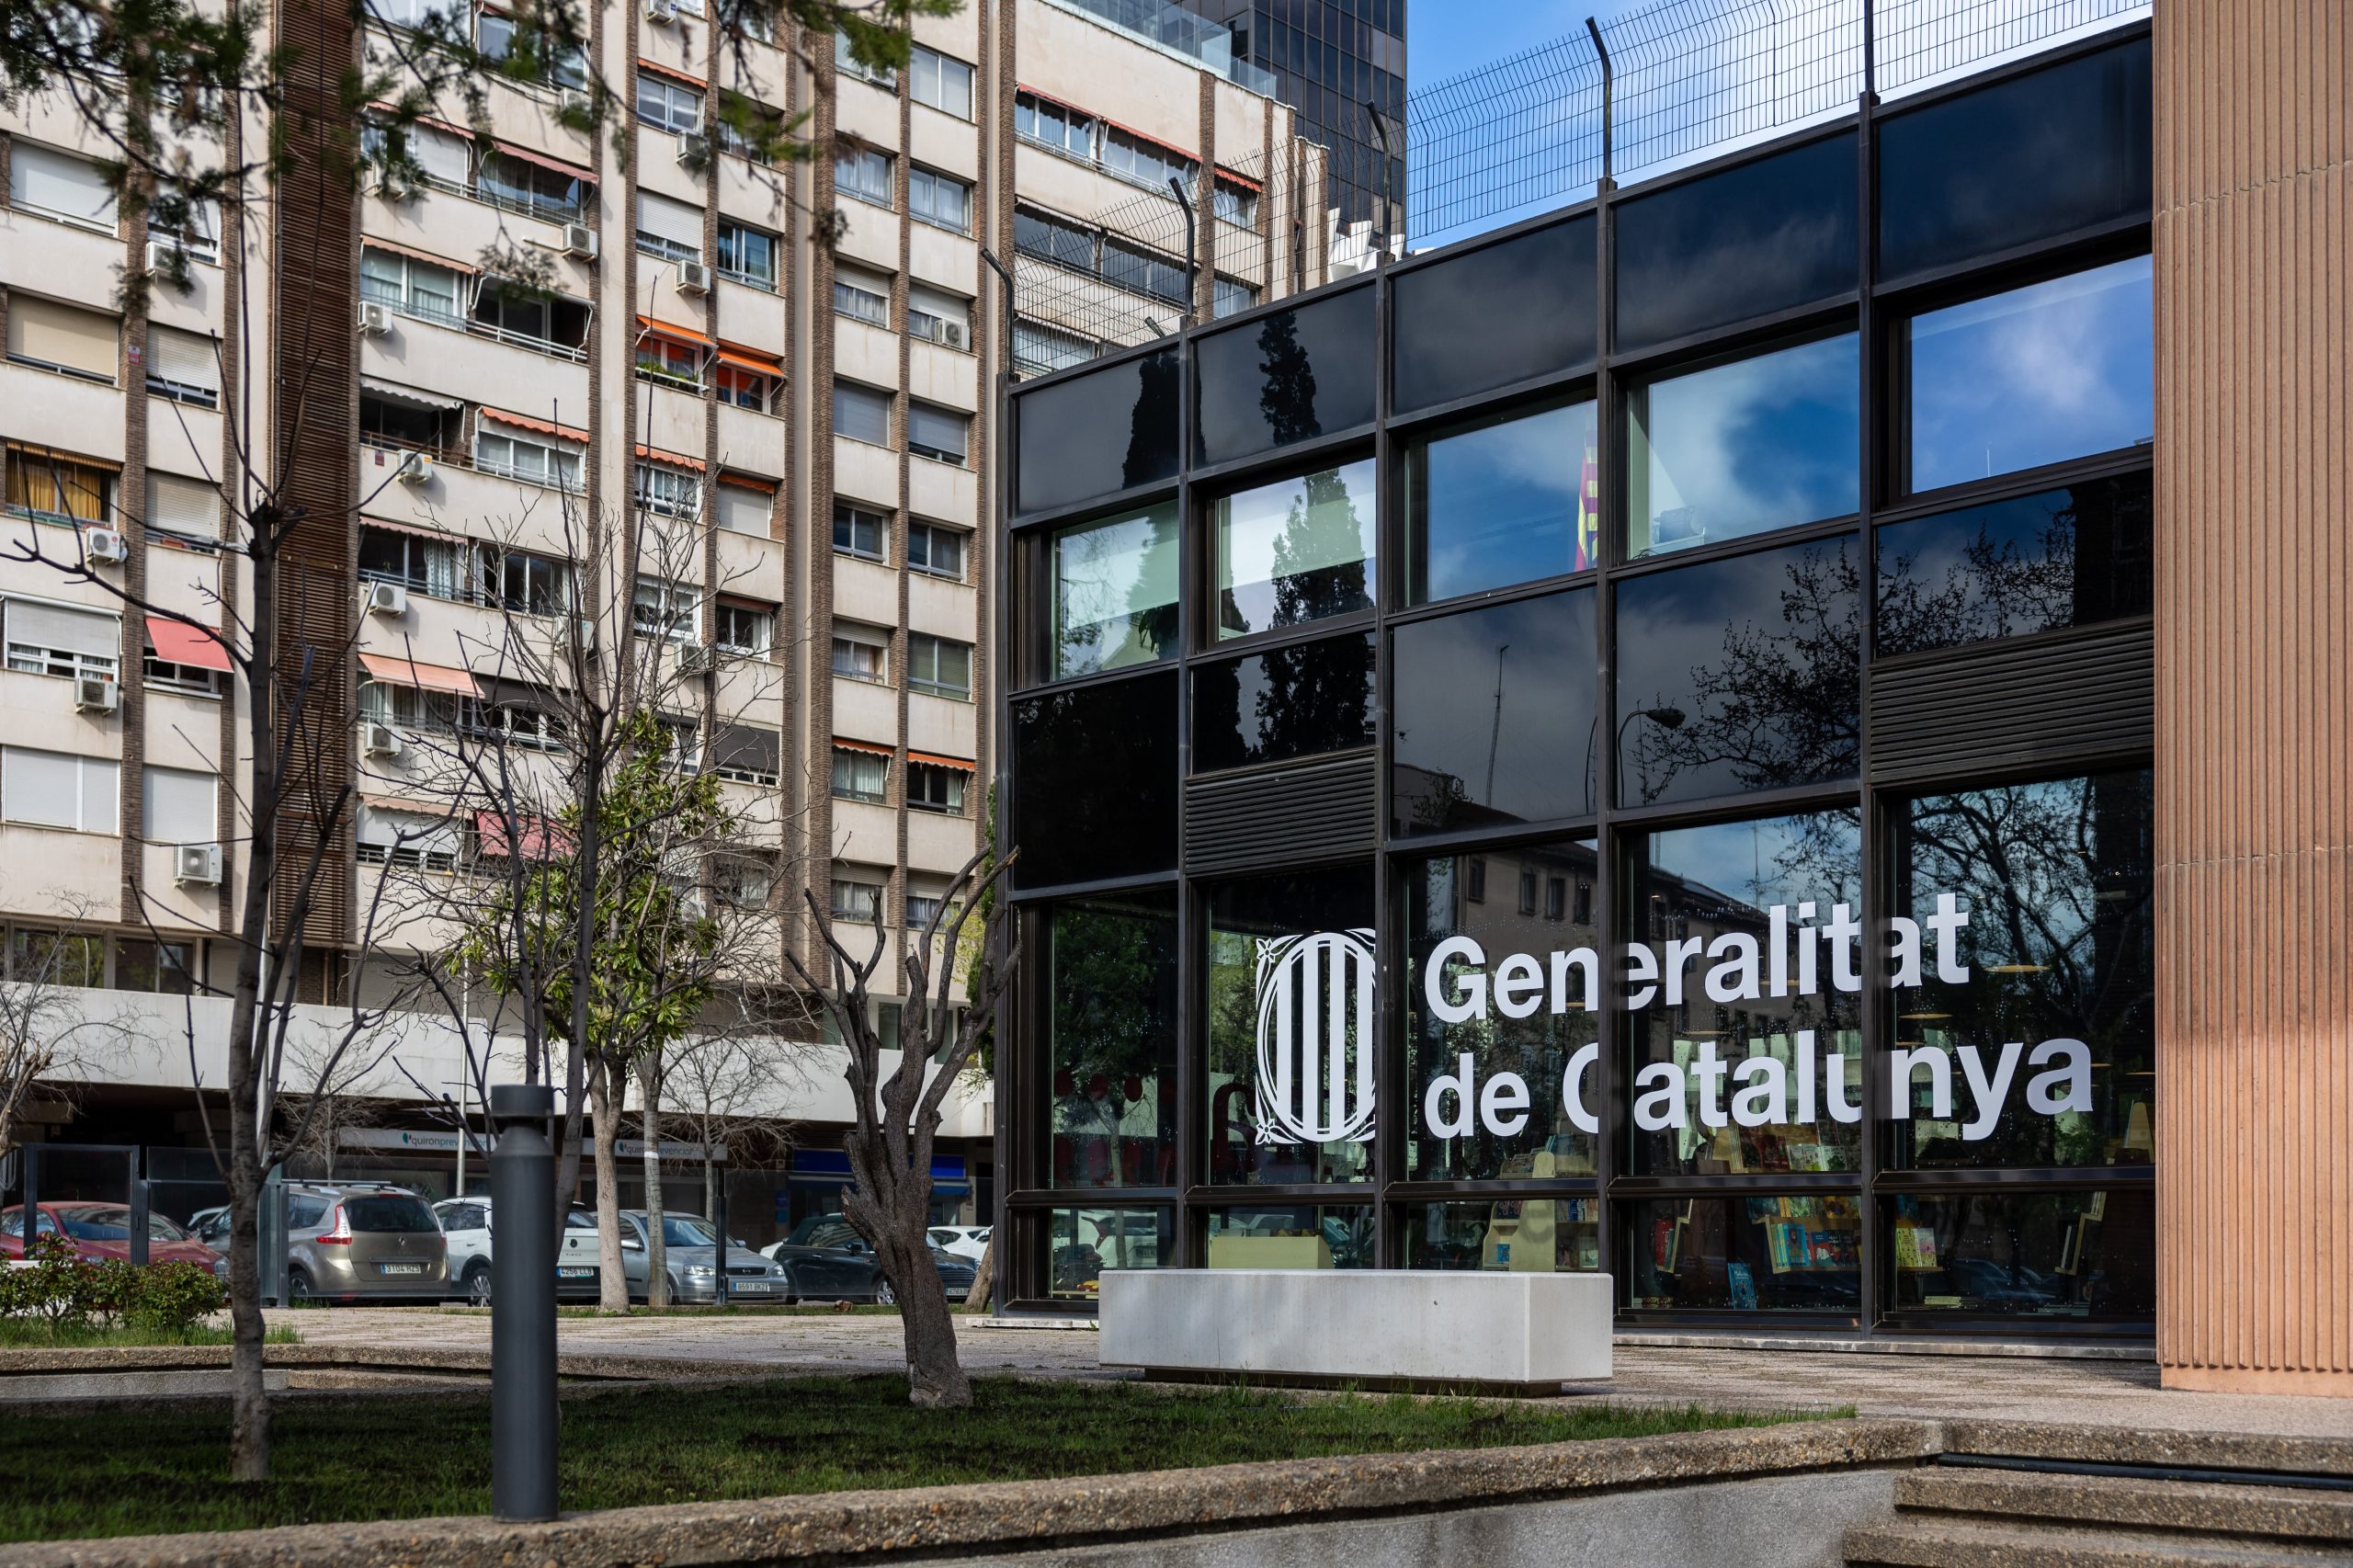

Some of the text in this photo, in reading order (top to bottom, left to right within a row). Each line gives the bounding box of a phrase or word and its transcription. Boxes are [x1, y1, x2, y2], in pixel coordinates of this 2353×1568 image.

[1426, 893, 1969, 1023] Generalitat
[1426, 1030, 2094, 1141] de Catalunya
[386, 1264, 405, 1272] 3104
